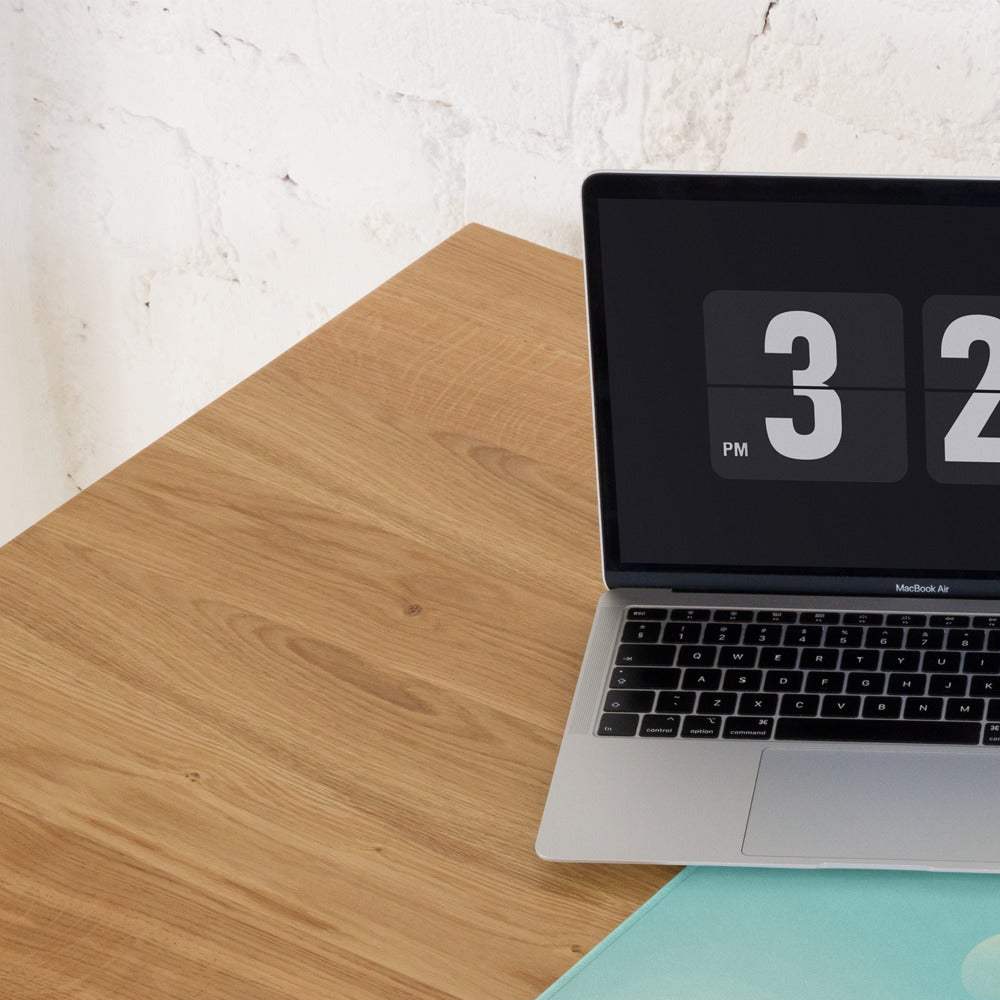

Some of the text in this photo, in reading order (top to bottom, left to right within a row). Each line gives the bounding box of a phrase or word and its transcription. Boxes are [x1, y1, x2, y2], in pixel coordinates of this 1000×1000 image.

[764, 310, 843, 460] 3
[723, 442, 749, 457] PM
[896, 584, 950, 593] MacBook Air
[693, 652, 702, 660] Q
[697, 675, 706, 683] A
[738, 676, 747, 684] S
[779, 677, 788, 685] D
[862, 679, 870, 687] G
